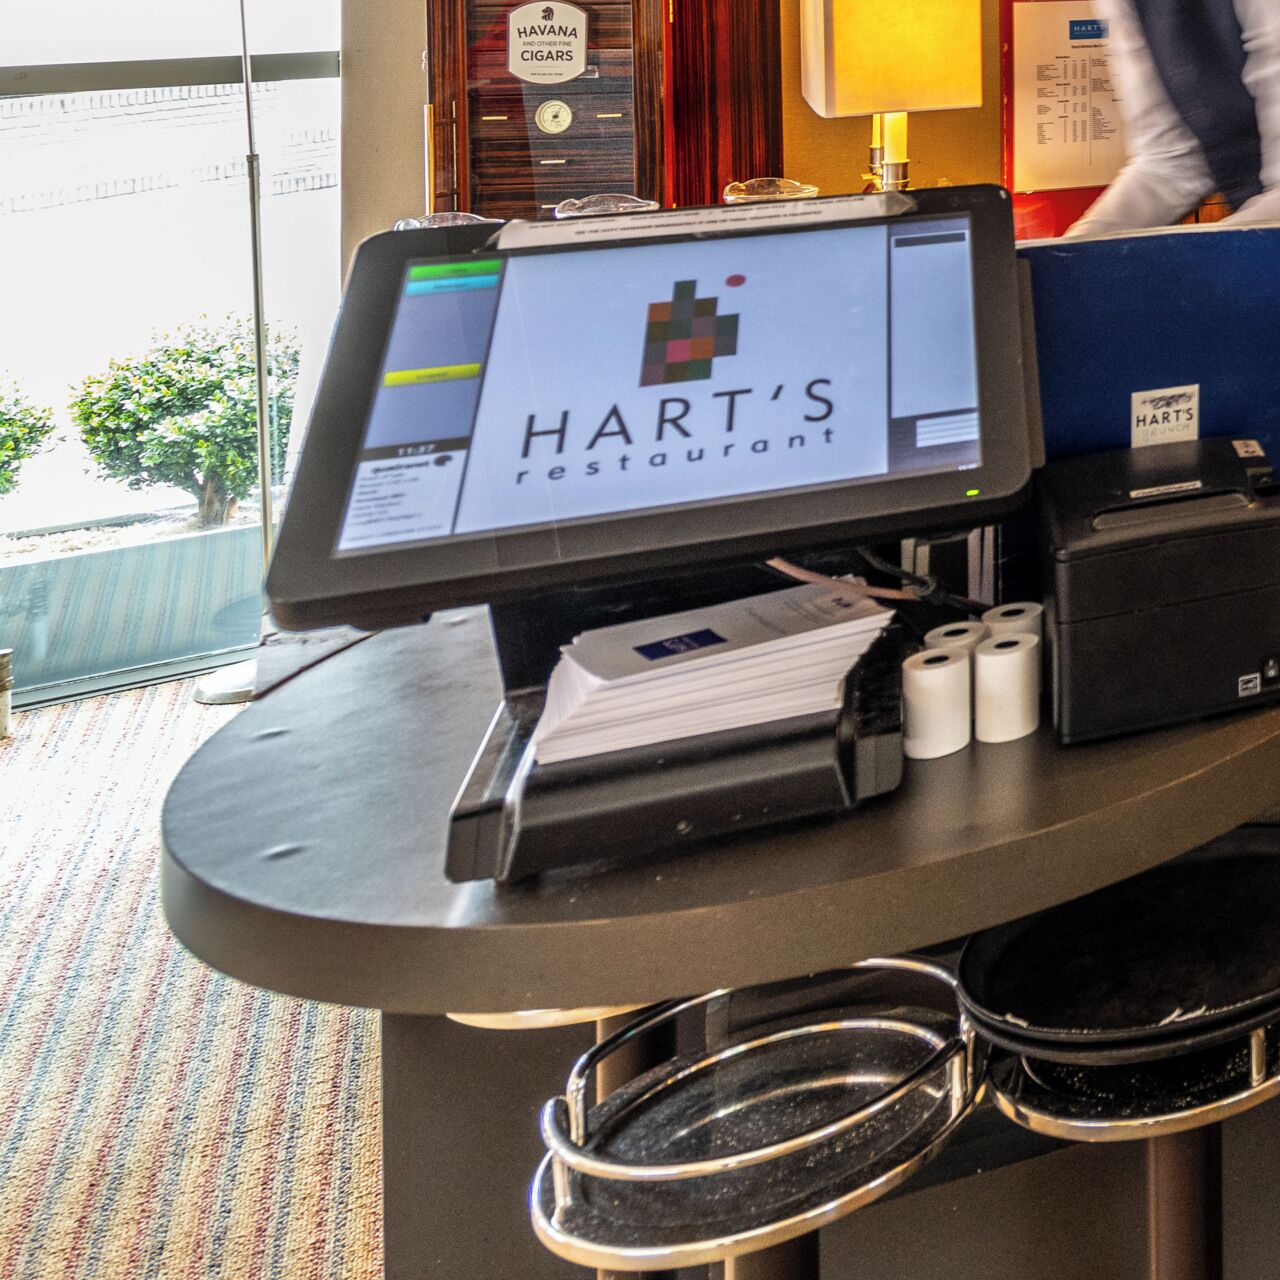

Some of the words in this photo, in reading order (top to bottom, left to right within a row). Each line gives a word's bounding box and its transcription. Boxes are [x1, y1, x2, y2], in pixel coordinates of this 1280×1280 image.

[517, 25, 578, 39] HAVANA
[520, 50, 573, 61] CIGARS
[521, 379, 834, 458] HART'S
[1136, 408, 1194, 427] HART'S
[516, 428, 834, 485] restaurant
